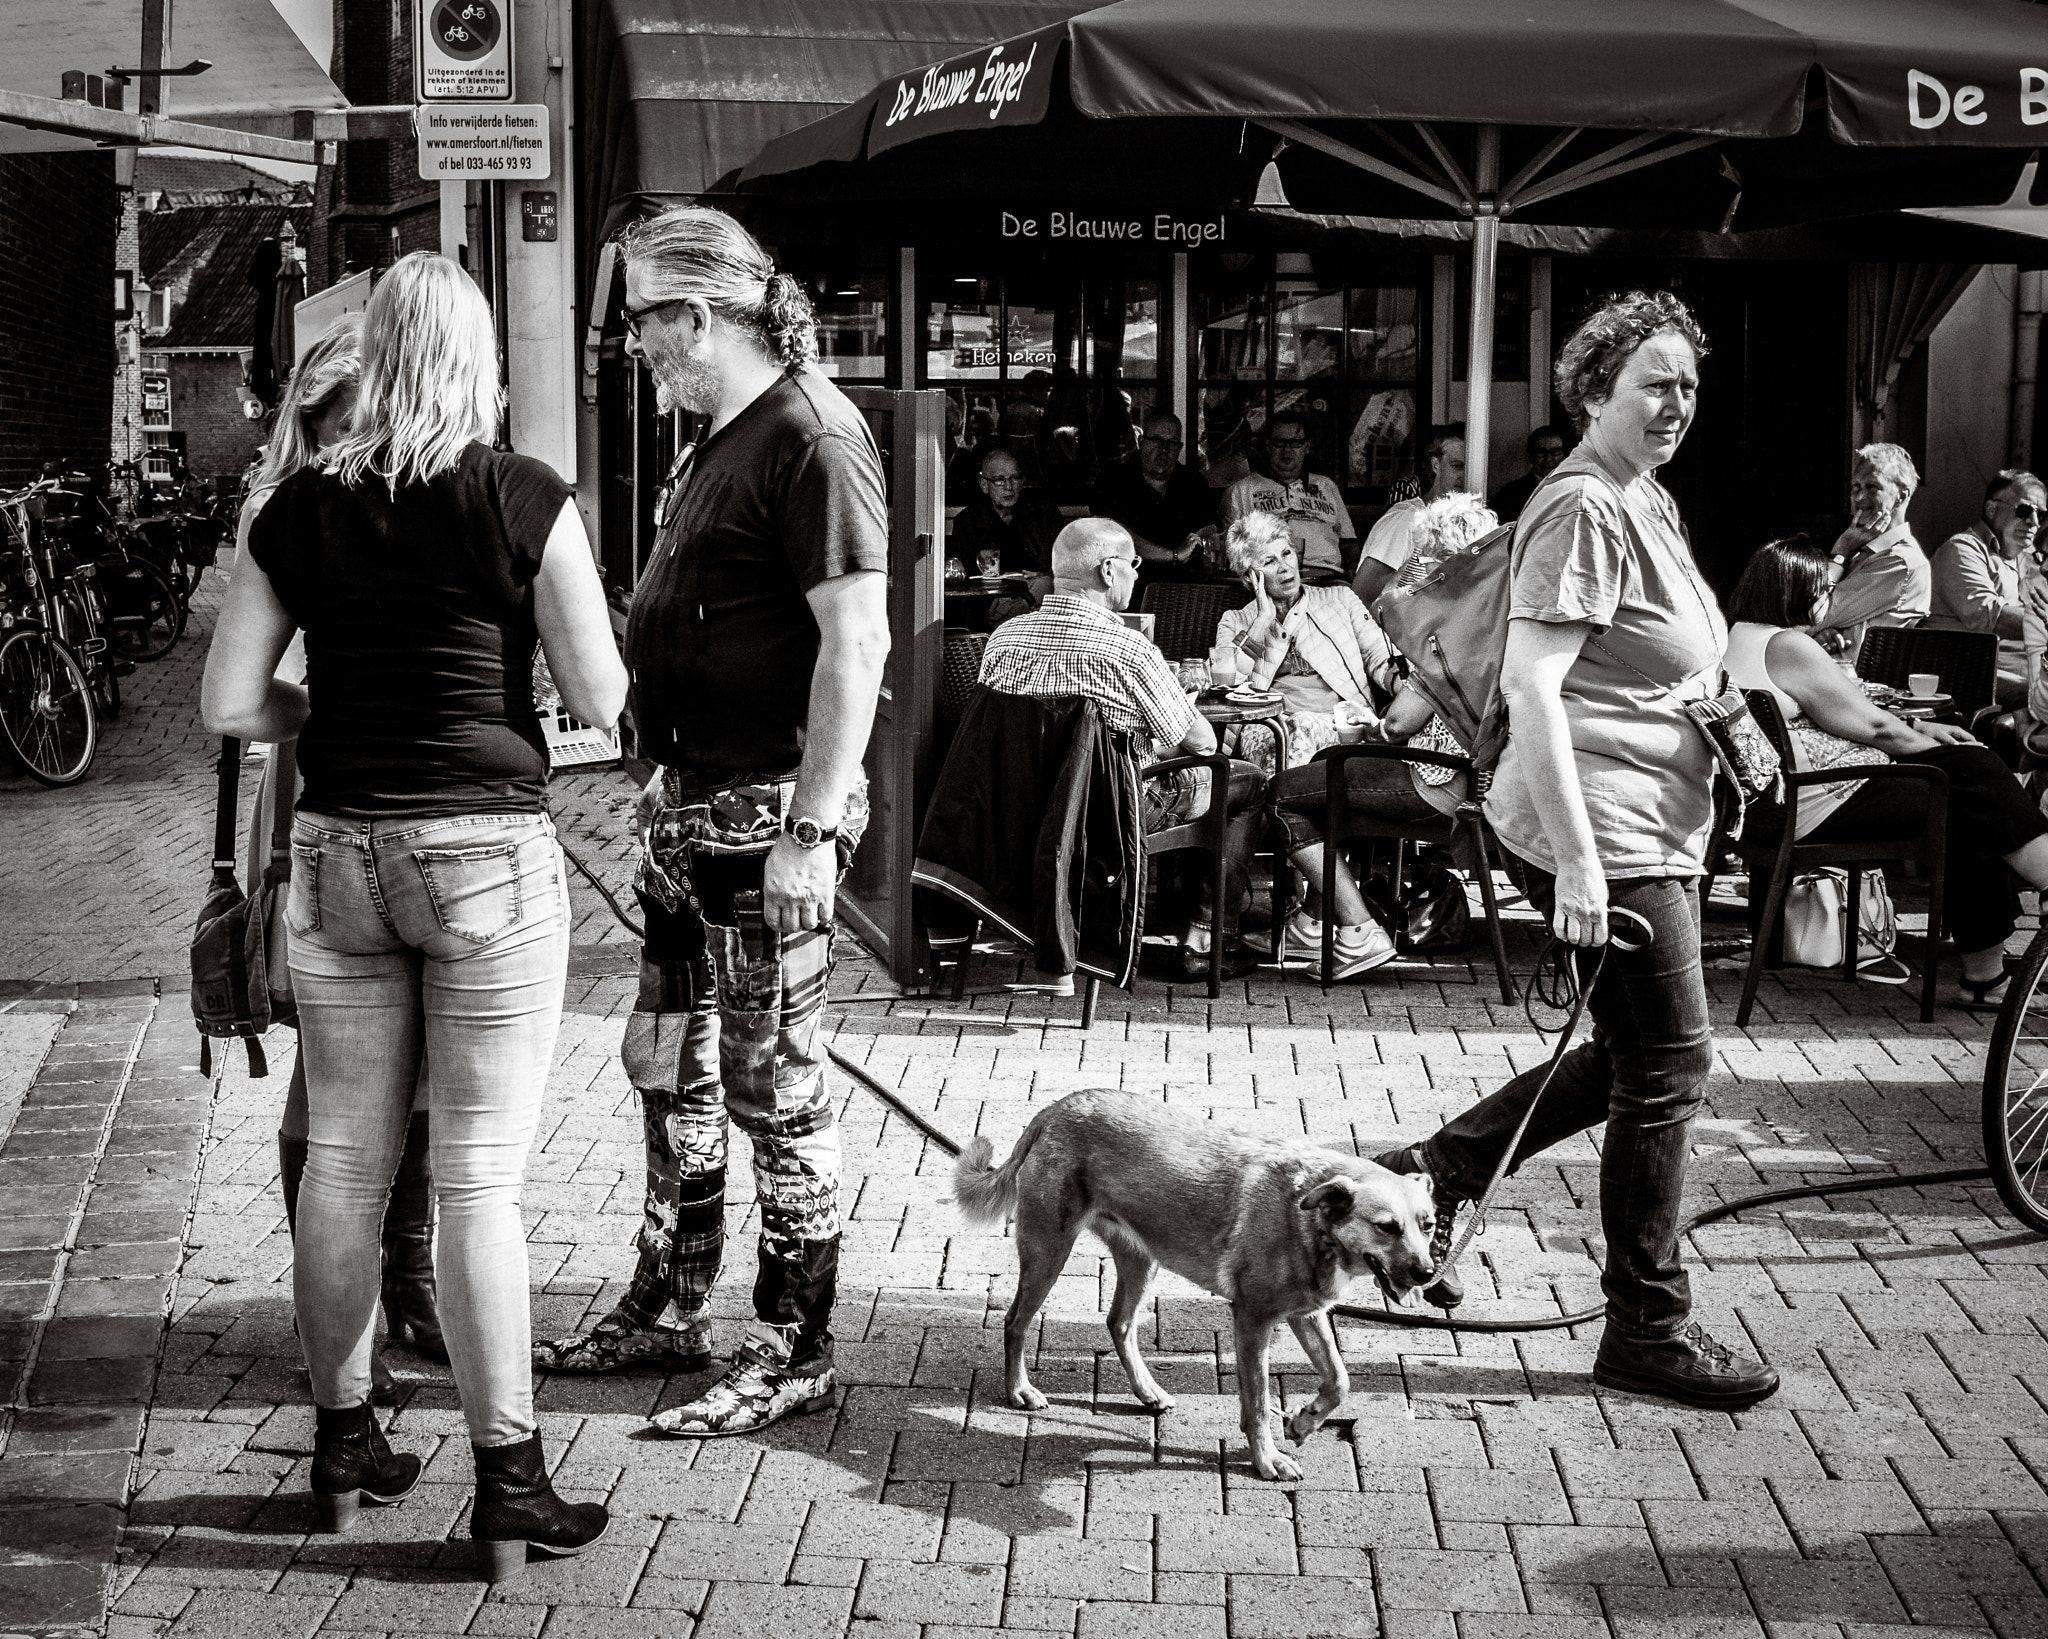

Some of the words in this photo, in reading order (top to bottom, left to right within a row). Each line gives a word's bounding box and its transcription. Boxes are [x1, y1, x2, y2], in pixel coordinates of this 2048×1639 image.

[428, 68, 482, 77] Uitgezonderd
[468, 77, 506, 85] klemmen
[886, 80, 915, 126] De
[914, 64, 976, 118] Blauwe
[974, 42, 1037, 119] Engel
[434, 85, 454, 94] (art.
[456, 85, 474, 94] 5:12
[476, 85, 499, 94] APV)
[1908, 69, 1988, 129] De
[430, 114, 448, 128] Info
[450, 114, 503, 131] verwijderde
[505, 114, 538, 128] fietsen:
[426, 135, 543, 150] www.amersfoort.nl/fietsen
[439, 157, 448, 170] of
[450, 157, 464, 170] bel
[466, 157, 504, 170] 033-465
[506, 157, 518, 170] 93
[520, 157, 532, 170] 93
[1002, 212, 1038, 237] De
[1050, 212, 1143, 239] Blauwe
[1154, 215, 1226, 247] Engel
[972, 348, 1056, 365] Heineken
